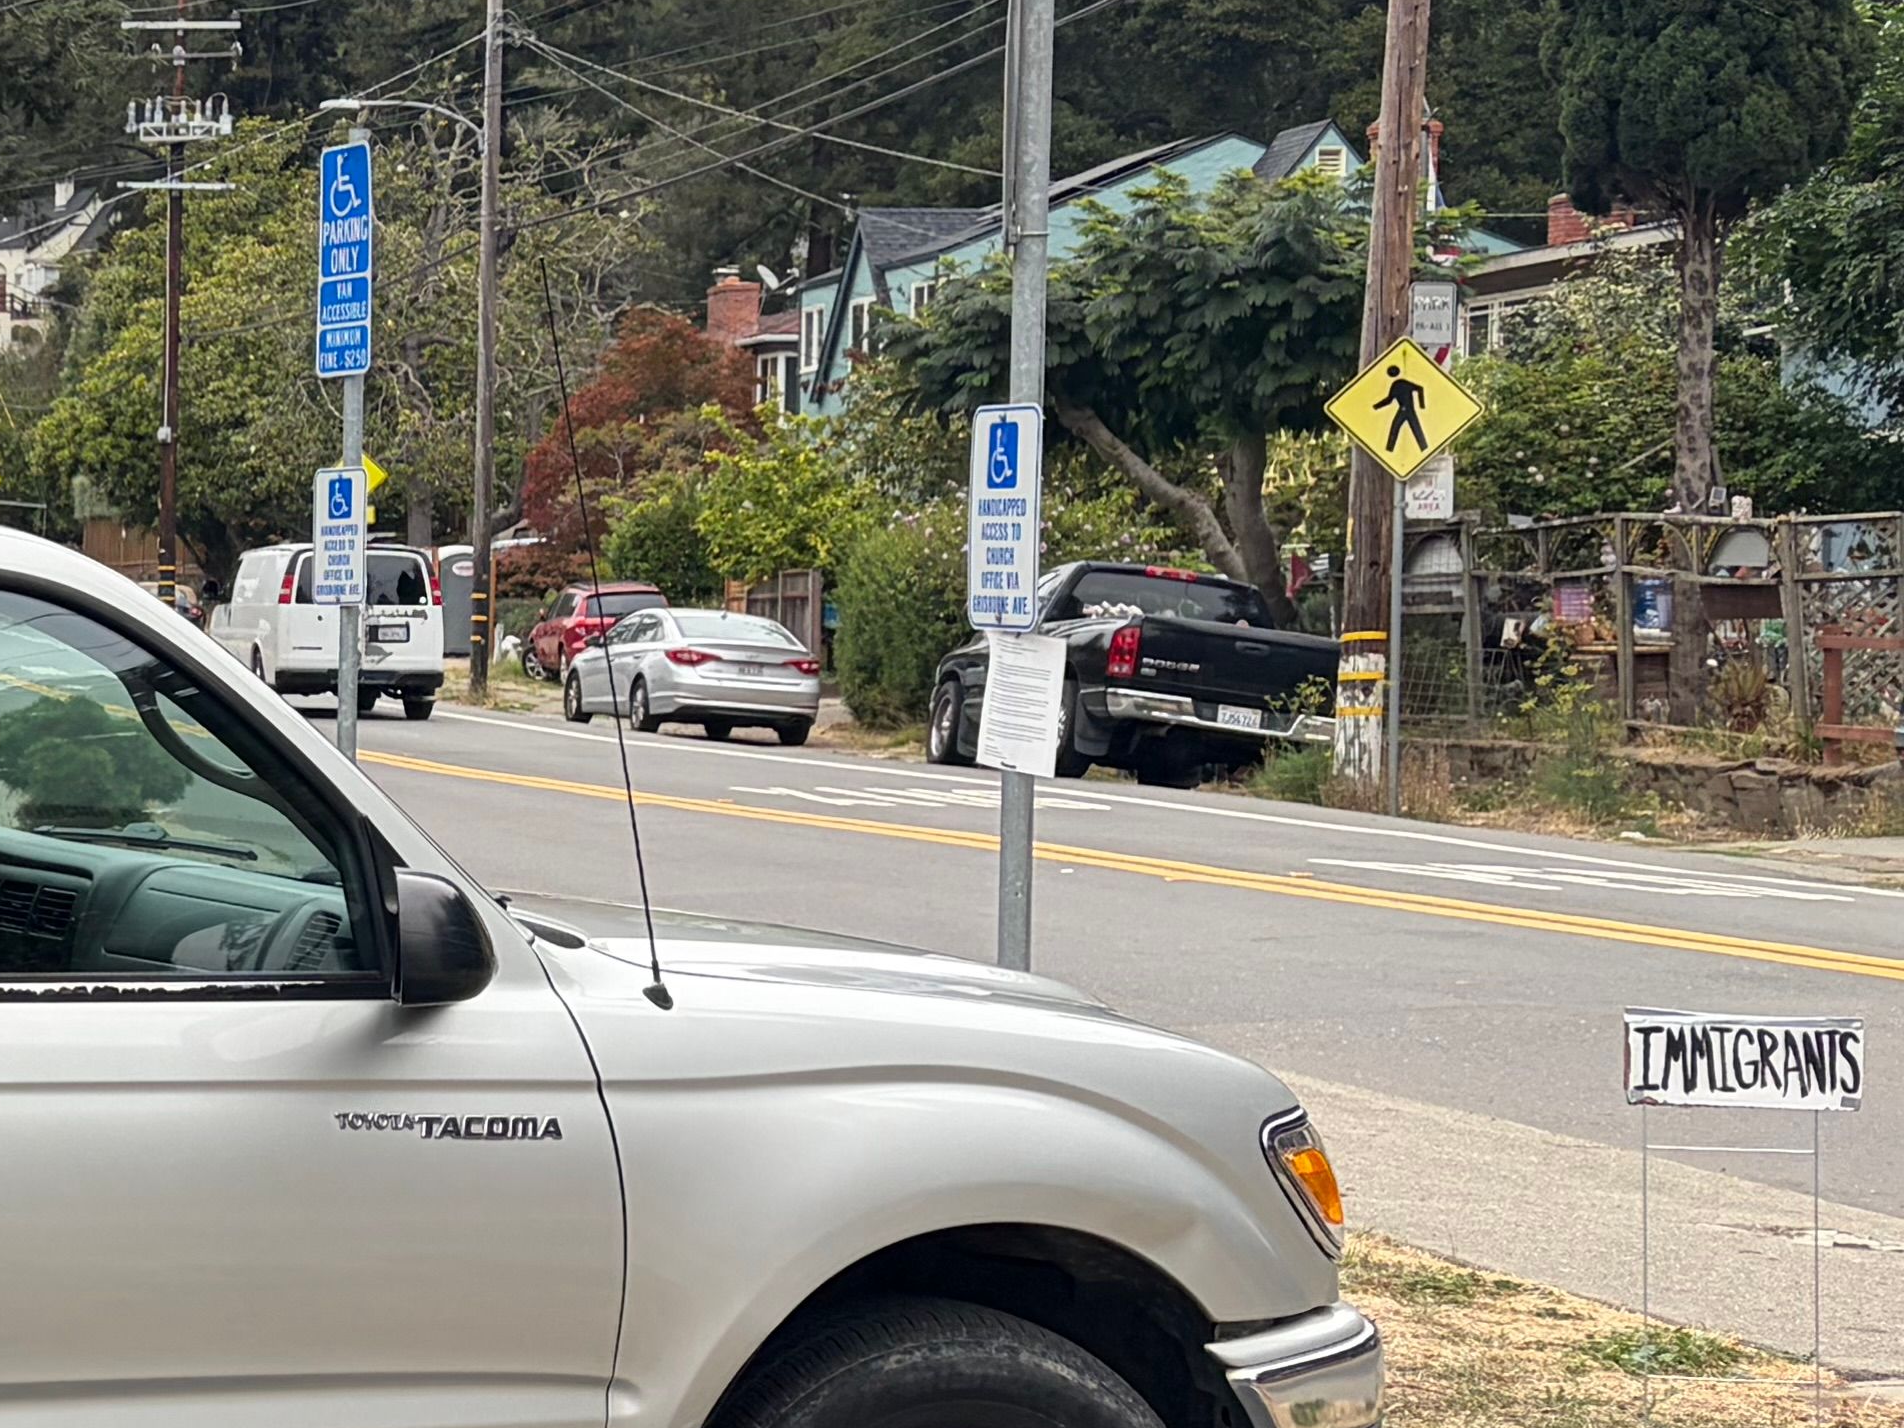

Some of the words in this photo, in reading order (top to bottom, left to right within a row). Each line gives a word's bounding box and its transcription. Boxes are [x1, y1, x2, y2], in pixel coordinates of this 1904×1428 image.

[323, 215, 368, 246] PARKING
[331, 245, 359, 273] ONLY
[337, 281, 352, 300] VAN
[321, 300, 367, 322] ACCESSIBLE
[326, 328, 361, 348] MINIMUM
[320, 351, 338, 369] FINE
[344, 348, 367, 368] $250
[978, 498, 1026, 517] HANDICAPPED
[321, 524, 358, 536] HANDICAPPED
[982, 523, 1008, 541] ACCESS
[1012, 523, 1021, 541] TO
[324, 539, 346, 551] ACCESS
[328, 554, 350, 566] CHURCH
[987, 547, 1014, 565] CHURCH
[323, 570, 342, 580] OFFICE
[982, 572, 1003, 589] OFFICE
[1007, 572, 1019, 590] VIA
[1633, 1025, 1861, 1098] IMMIGRANTS
[334, 1112, 414, 1130] TOYOTA
[415, 1115, 563, 1140] TACOMA
